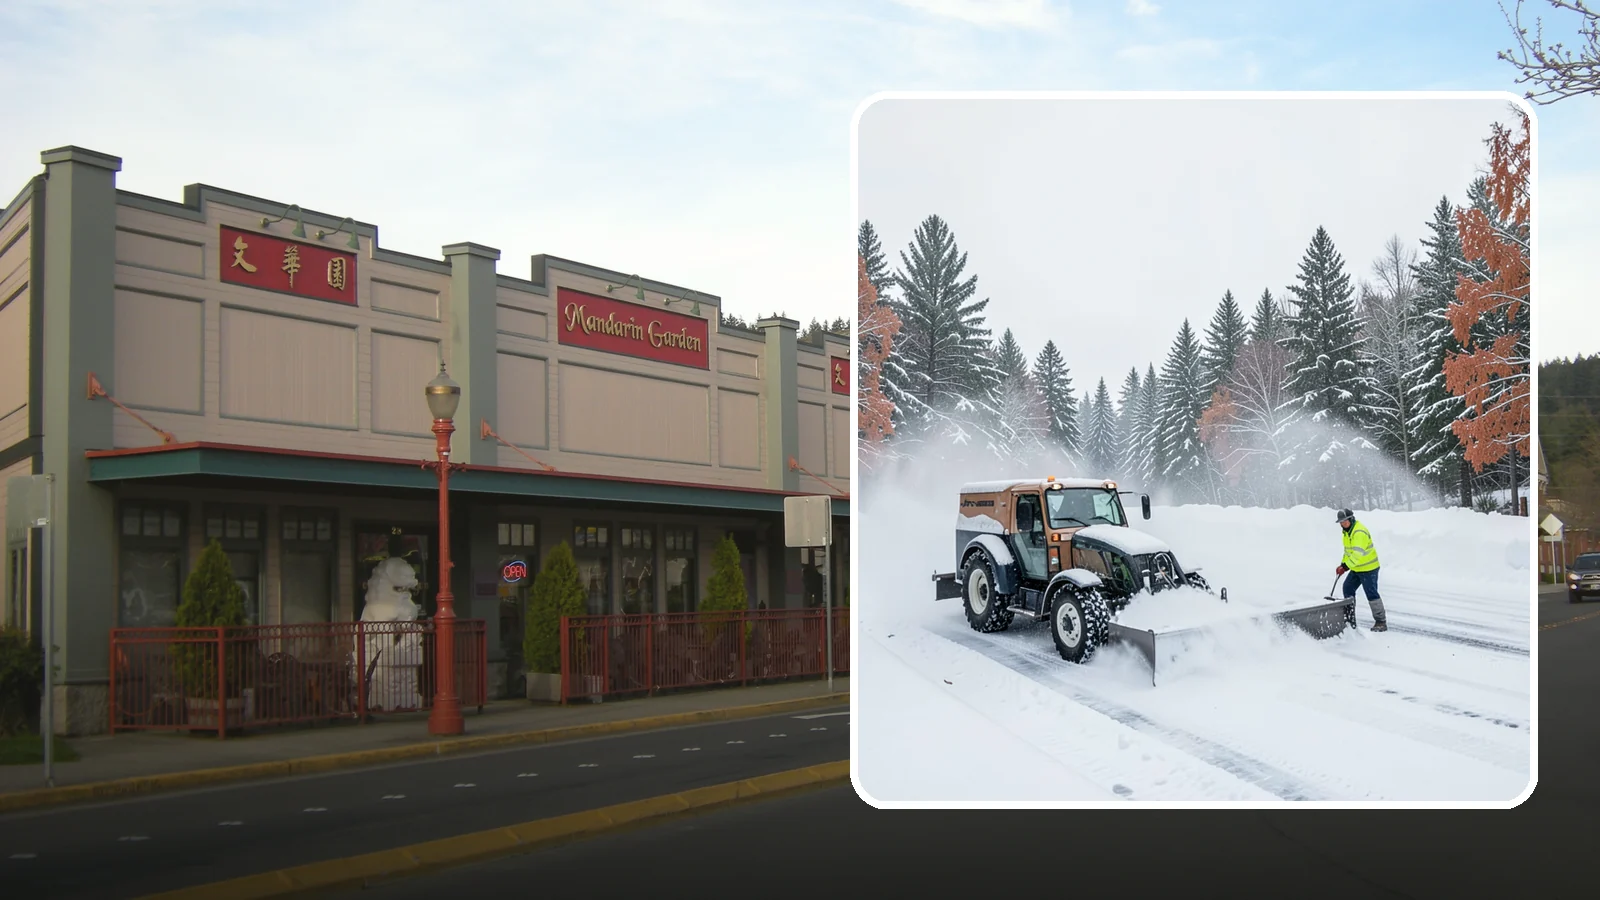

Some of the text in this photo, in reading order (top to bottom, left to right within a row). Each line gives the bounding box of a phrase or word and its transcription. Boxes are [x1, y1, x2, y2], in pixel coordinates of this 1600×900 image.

[231, 235, 346, 291] 文華園
[564, 302, 701, 352] Mandarin Garden
[503, 565, 527, 578] OPEN
